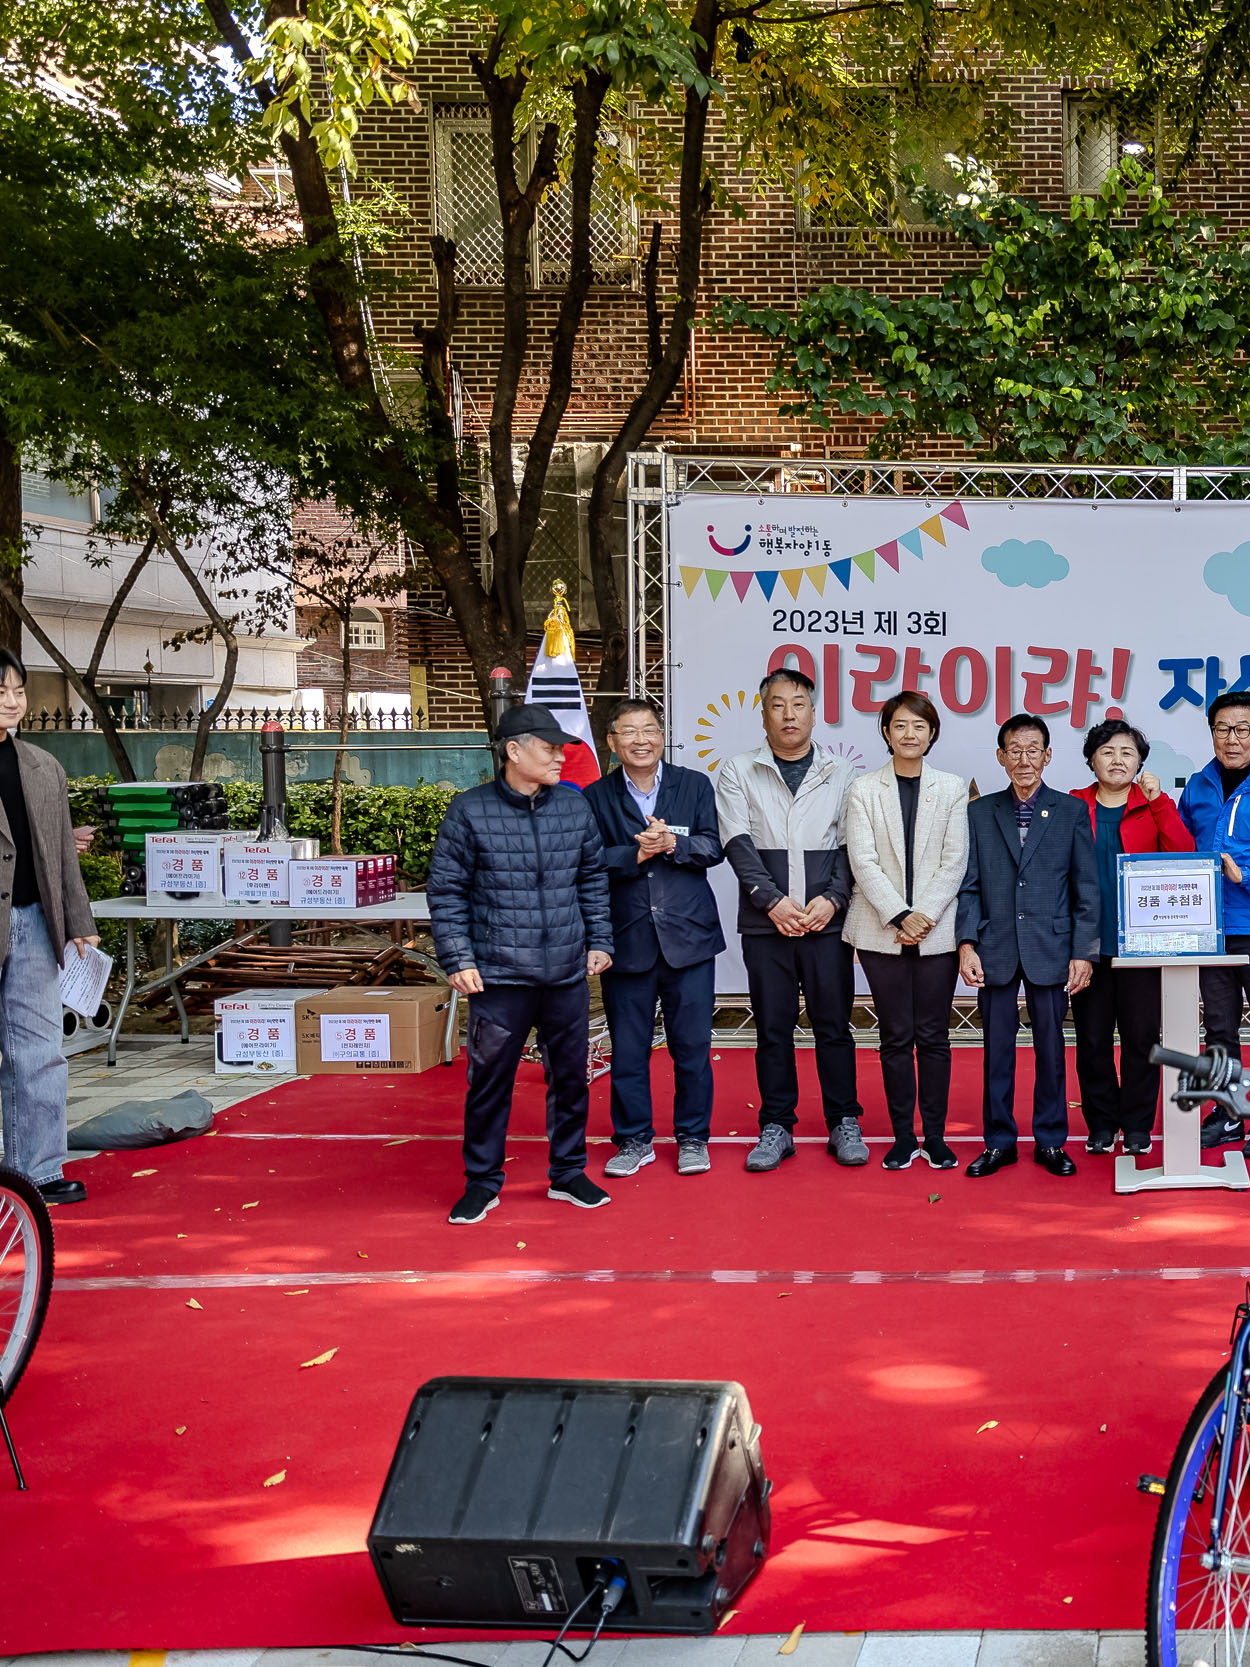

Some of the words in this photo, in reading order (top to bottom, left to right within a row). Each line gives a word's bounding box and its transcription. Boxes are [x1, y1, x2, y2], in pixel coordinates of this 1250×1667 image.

[759, 537, 832, 557] 행복자양1동
[772, 609, 866, 637] 2023년
[873, 610, 898, 636] 제
[907, 610, 947, 636] 3회
[150, 836, 178, 844] Tefal
[1137, 895, 1160, 908] 경품
[1167, 893, 1203, 907] 추첨함
[219, 1003, 251, 1011] Tefal
